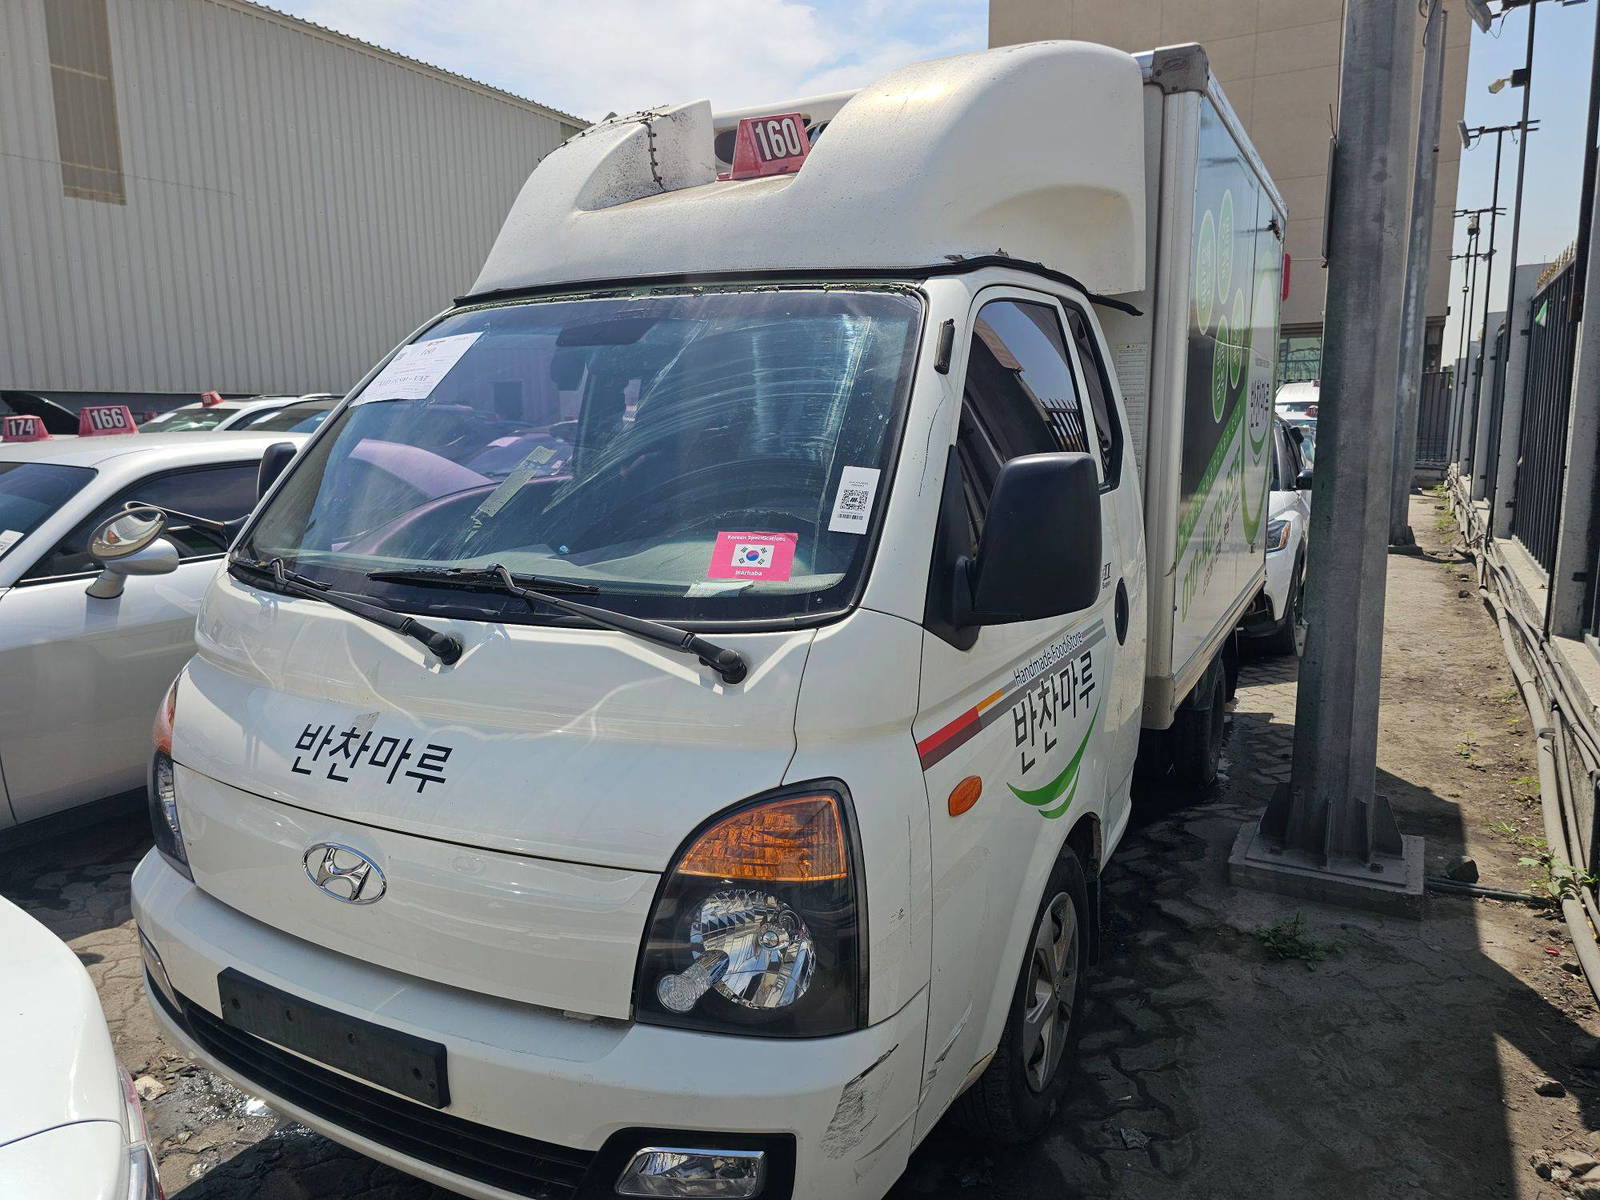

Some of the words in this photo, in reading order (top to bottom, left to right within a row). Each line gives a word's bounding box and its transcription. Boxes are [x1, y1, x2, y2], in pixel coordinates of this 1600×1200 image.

[755, 118, 802, 161] 160
[9, 419, 35, 436] 174
[91, 408, 126, 430] 166
[1013, 649, 1053, 686] Handmade
[1051, 637, 1067, 662] Food
[1065, 631, 1083, 651] Store
[1012, 650, 1096, 775] 반찬마루
[291, 723, 454, 794] 반찬마루
